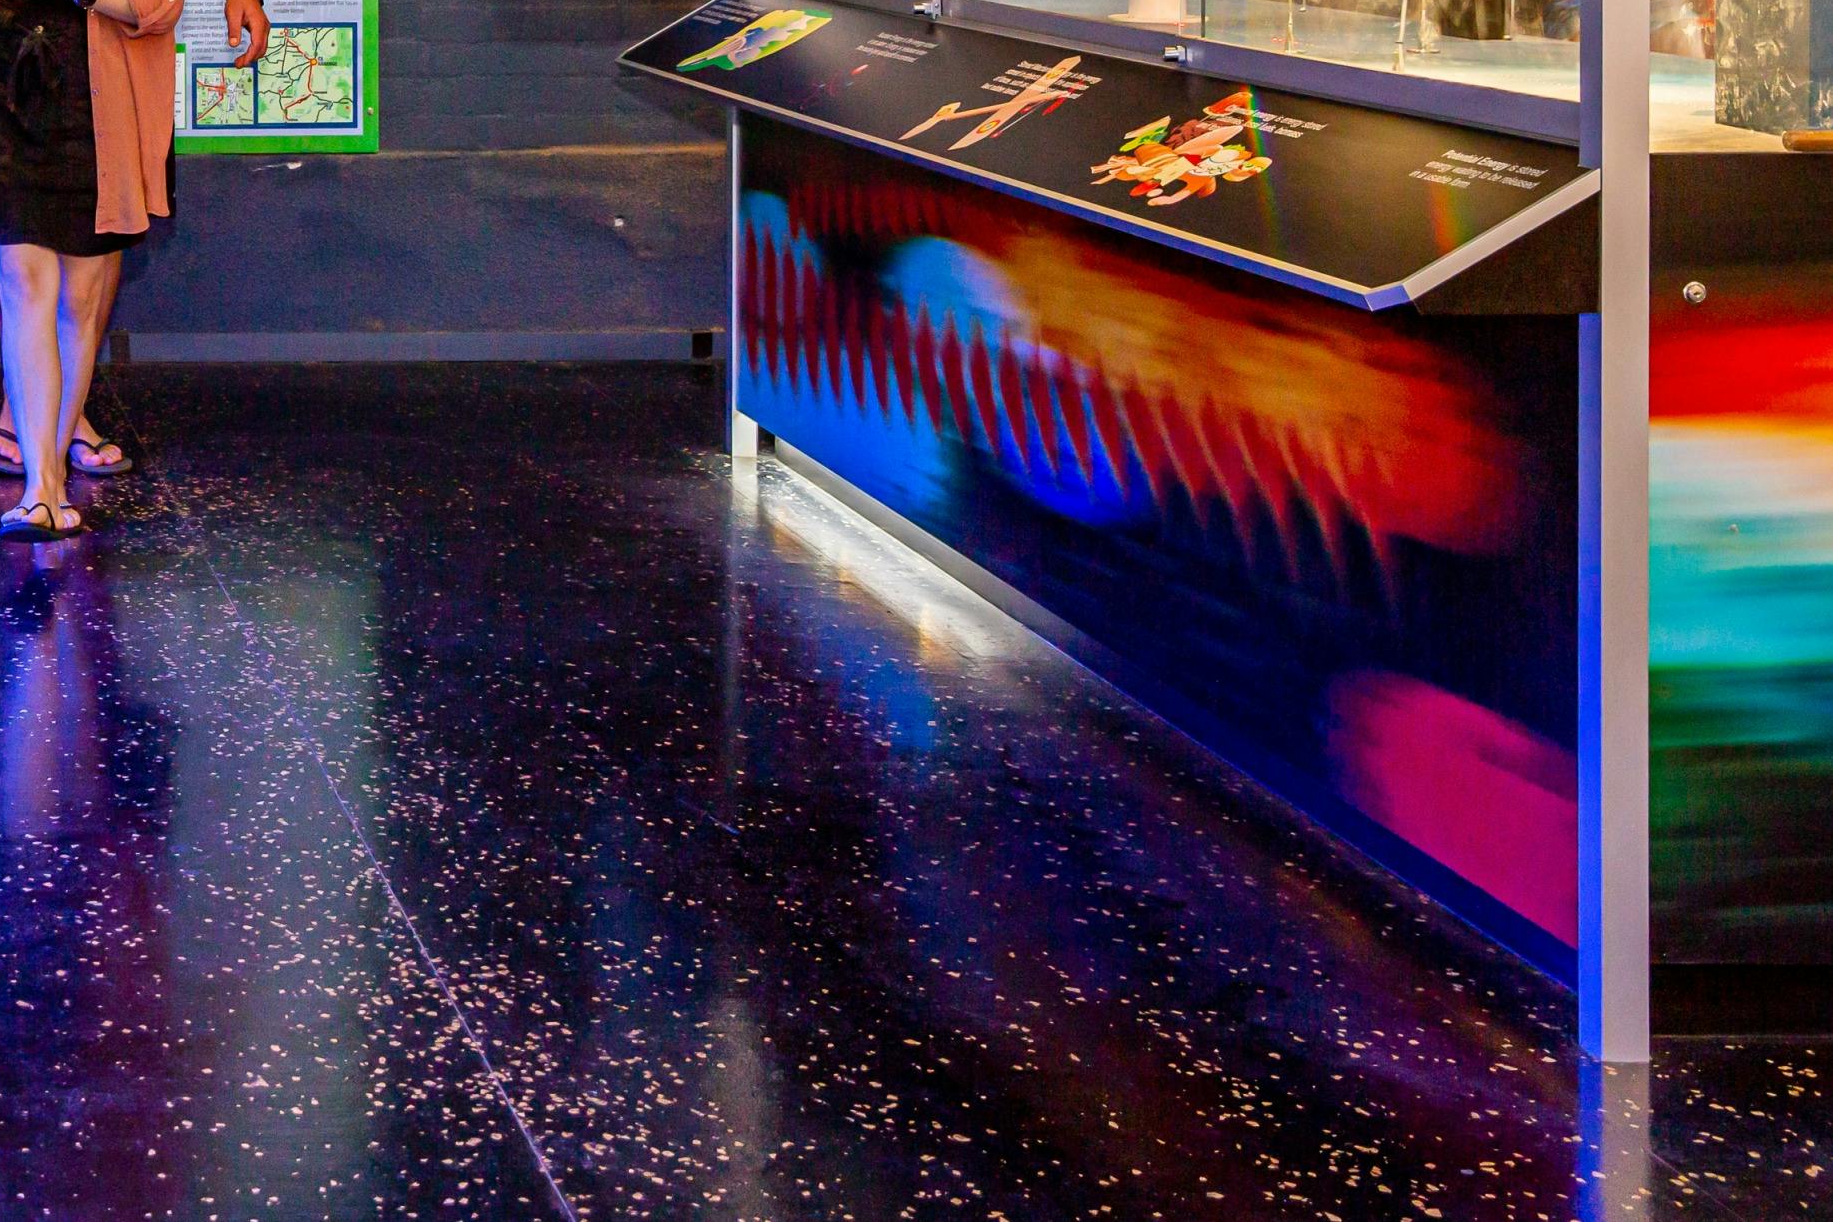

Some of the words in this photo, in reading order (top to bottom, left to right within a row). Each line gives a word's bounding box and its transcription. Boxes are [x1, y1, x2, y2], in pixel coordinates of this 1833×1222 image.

[1440, 149, 1484, 164] Potential
[1477, 157, 1512, 172] Energy
[1507, 163, 1520, 172] is
[1516, 166, 1549, 178] stored
